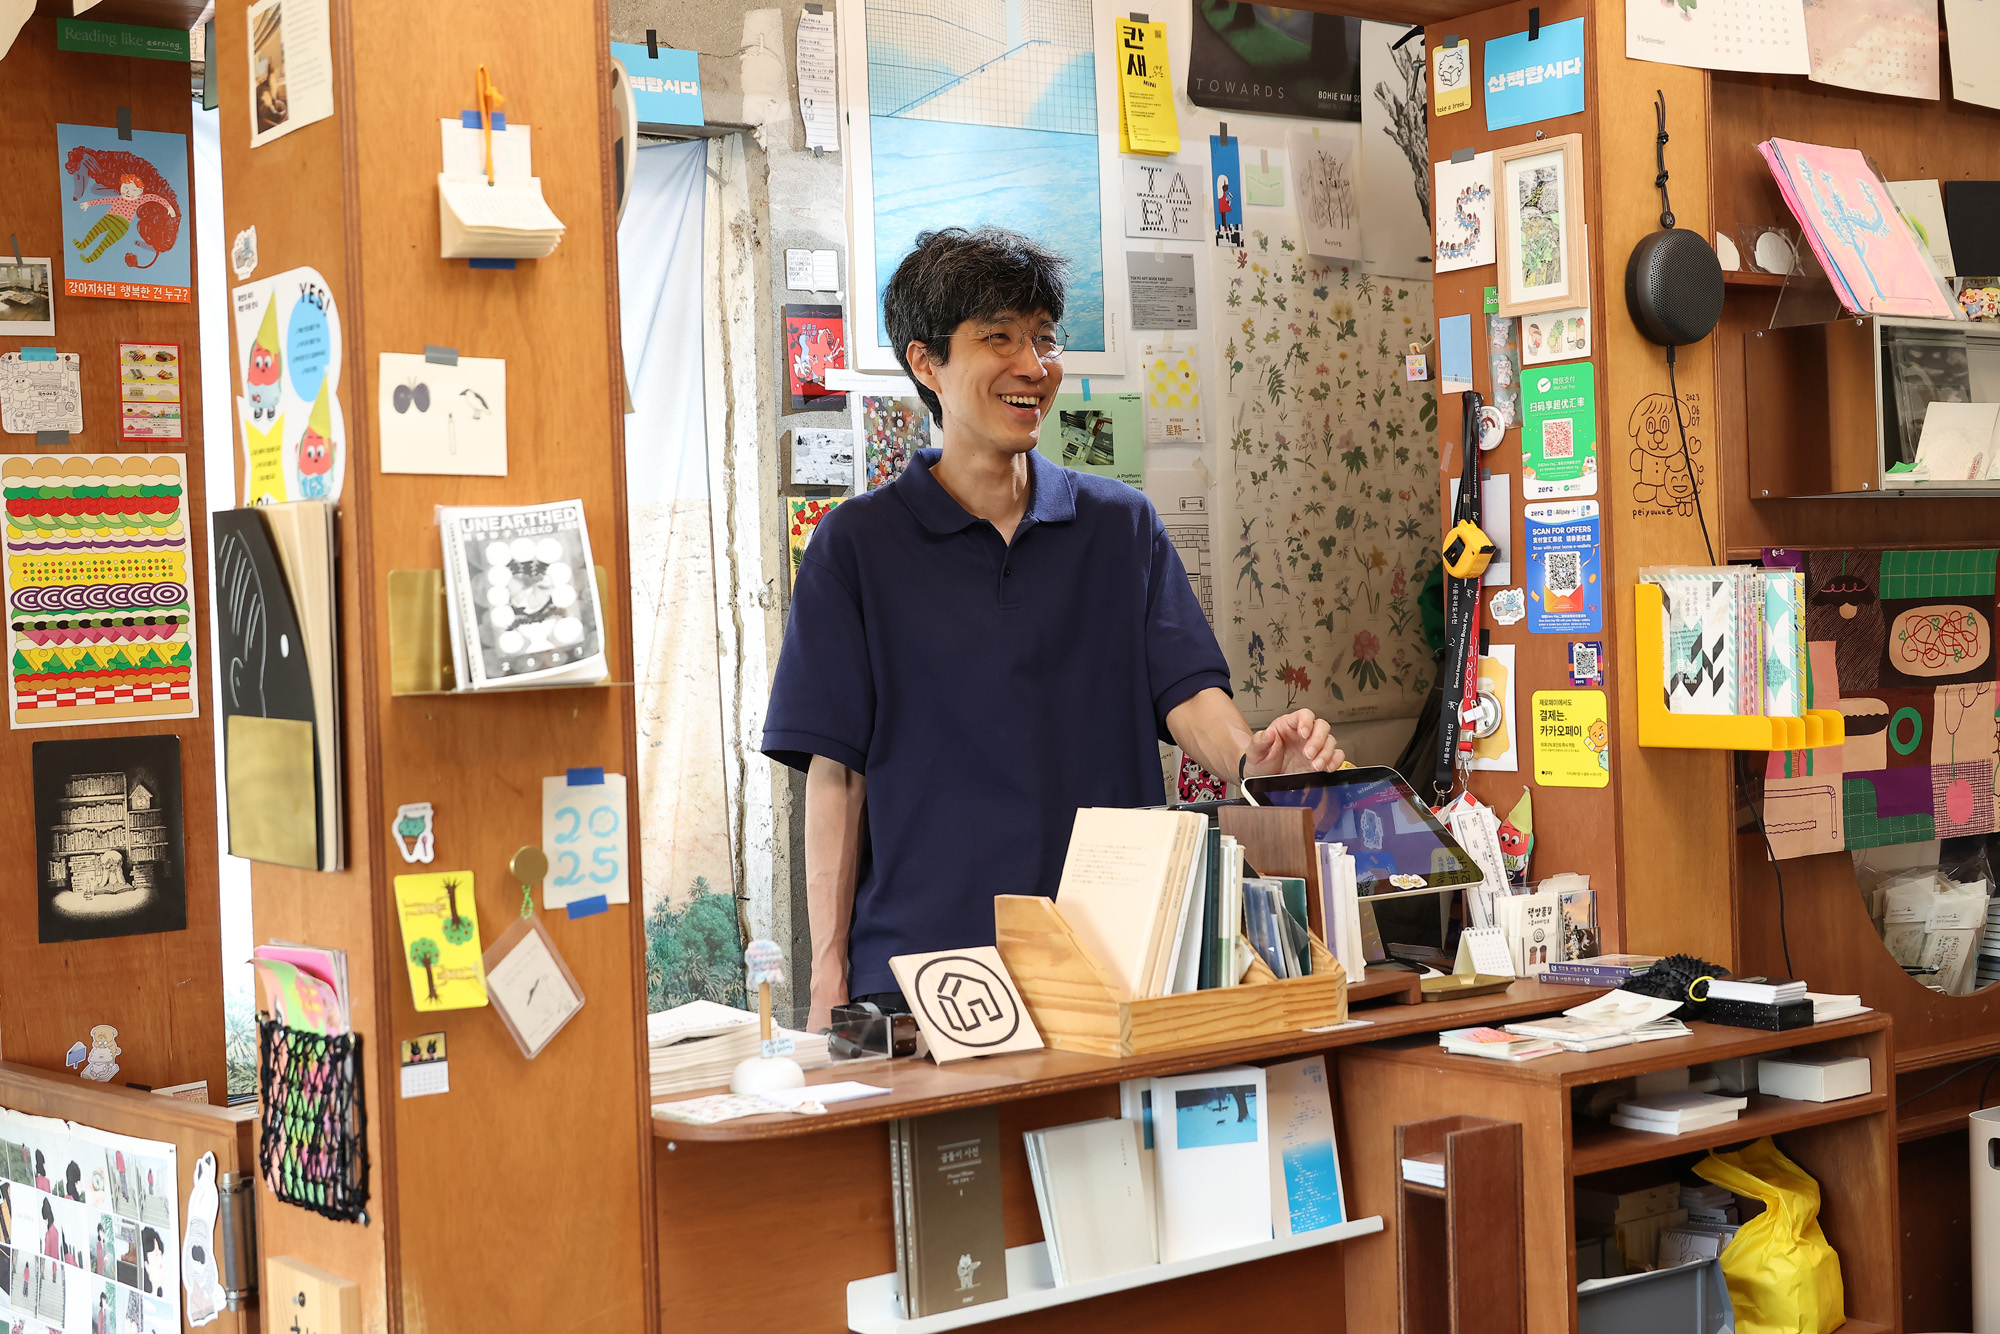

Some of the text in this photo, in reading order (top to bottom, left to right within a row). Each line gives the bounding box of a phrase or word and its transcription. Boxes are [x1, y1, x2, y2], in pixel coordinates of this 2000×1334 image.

[65, 27, 182, 50] Reading like earning.
[1641, 35, 1666, 45] September
[1487, 56, 1582, 93] 산책합시다
[1196, 78, 1284, 99] TOWARDS
[1318, 90, 1338, 100] BOHIE
[1340, 93, 1352, 102] KIM
[68, 282, 188, 301] 강아지처럼 행복한 건 누구?
[299, 282, 330, 317] YES!
[1530, 397, 1585, 412] 扫码享超优汇率
[1692, 405, 1700, 415] 06
[1691, 416, 1700, 427] 07
[1166, 424, 1190, 436] 星期一
[461, 507, 578, 533] UNEARTHED
[518, 525, 553, 537] TAEKO
[1566, 525, 1592, 533] OFFERS
[1460, 623, 1468, 638] Book
[1455, 638, 1465, 672] International
[1453, 672, 1461, 689] Seoul
[1465, 662, 1473, 699] 2023
[1540, 725, 1582, 737] 카카오페이
[1443, 723, 1454, 765] 서울국제도서전
